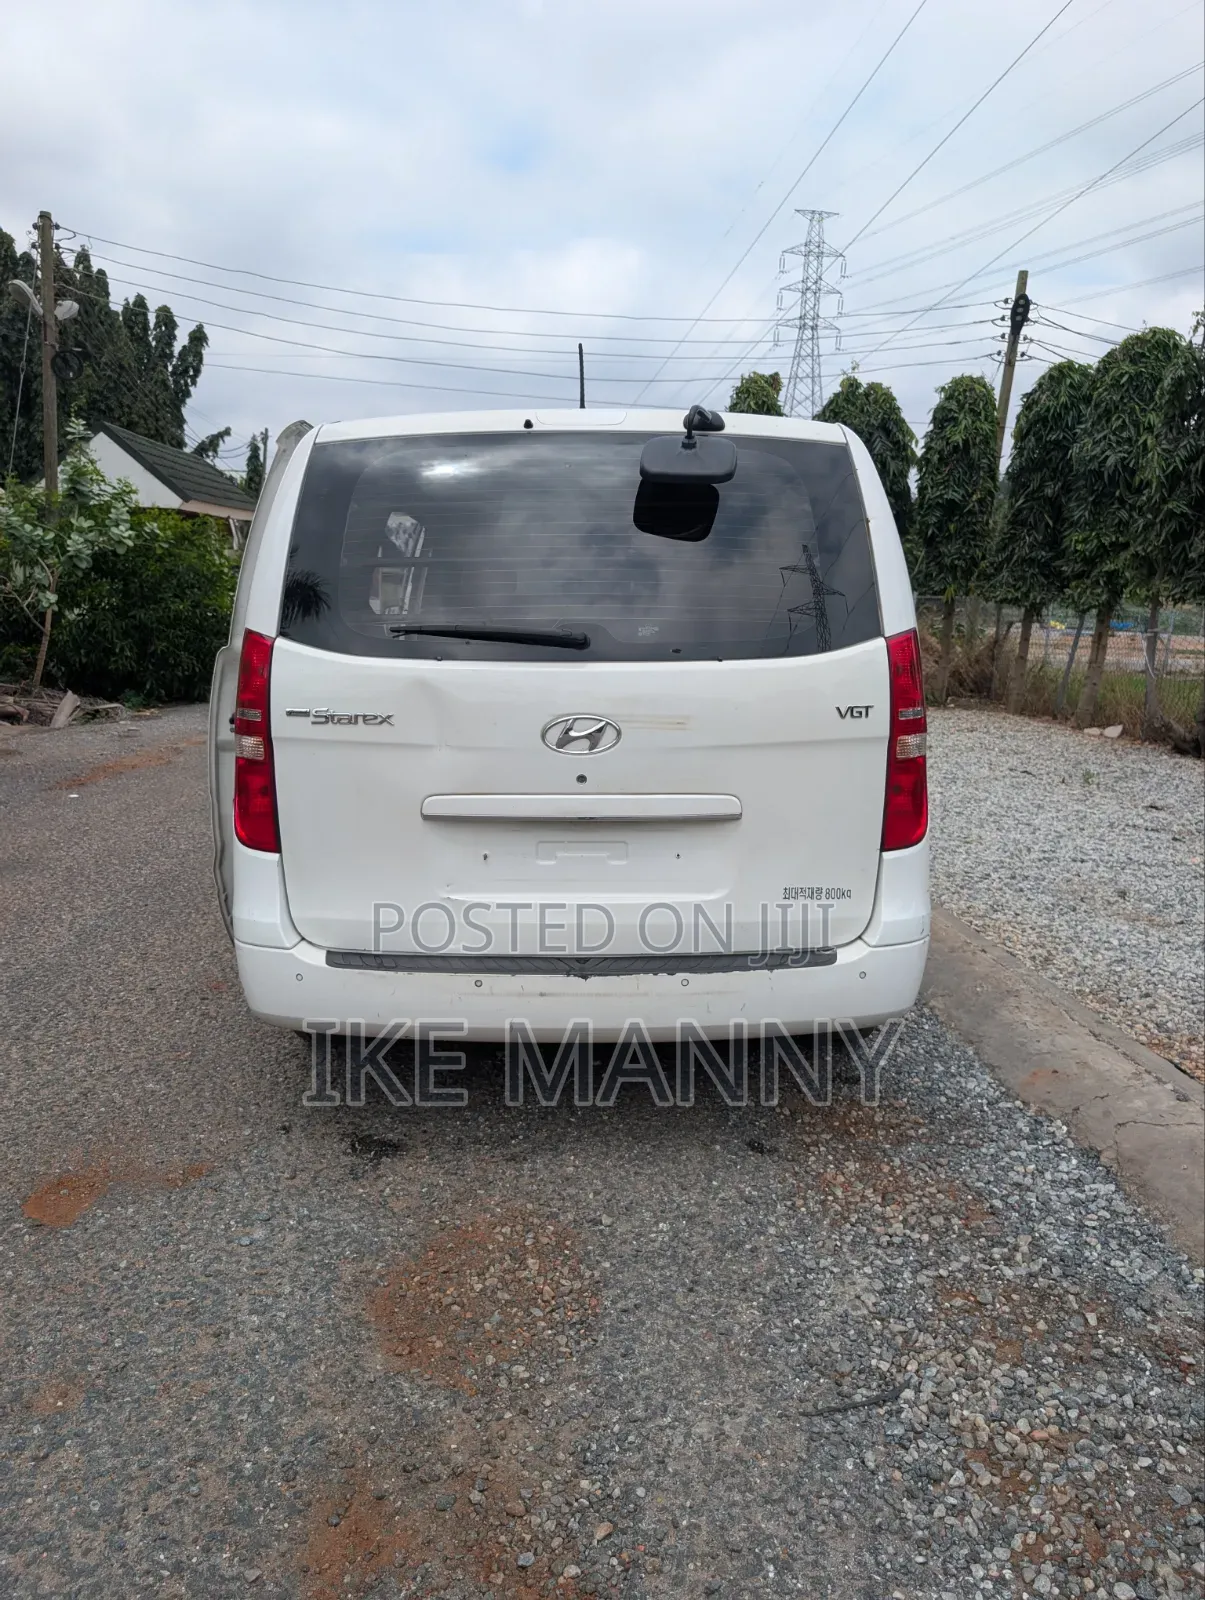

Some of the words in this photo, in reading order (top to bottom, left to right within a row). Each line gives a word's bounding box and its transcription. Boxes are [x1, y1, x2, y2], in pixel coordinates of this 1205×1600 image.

[311, 707, 395, 726] Starex
[834, 704, 875, 720] VGT
[782, 886, 823, 901] 최대적재량
